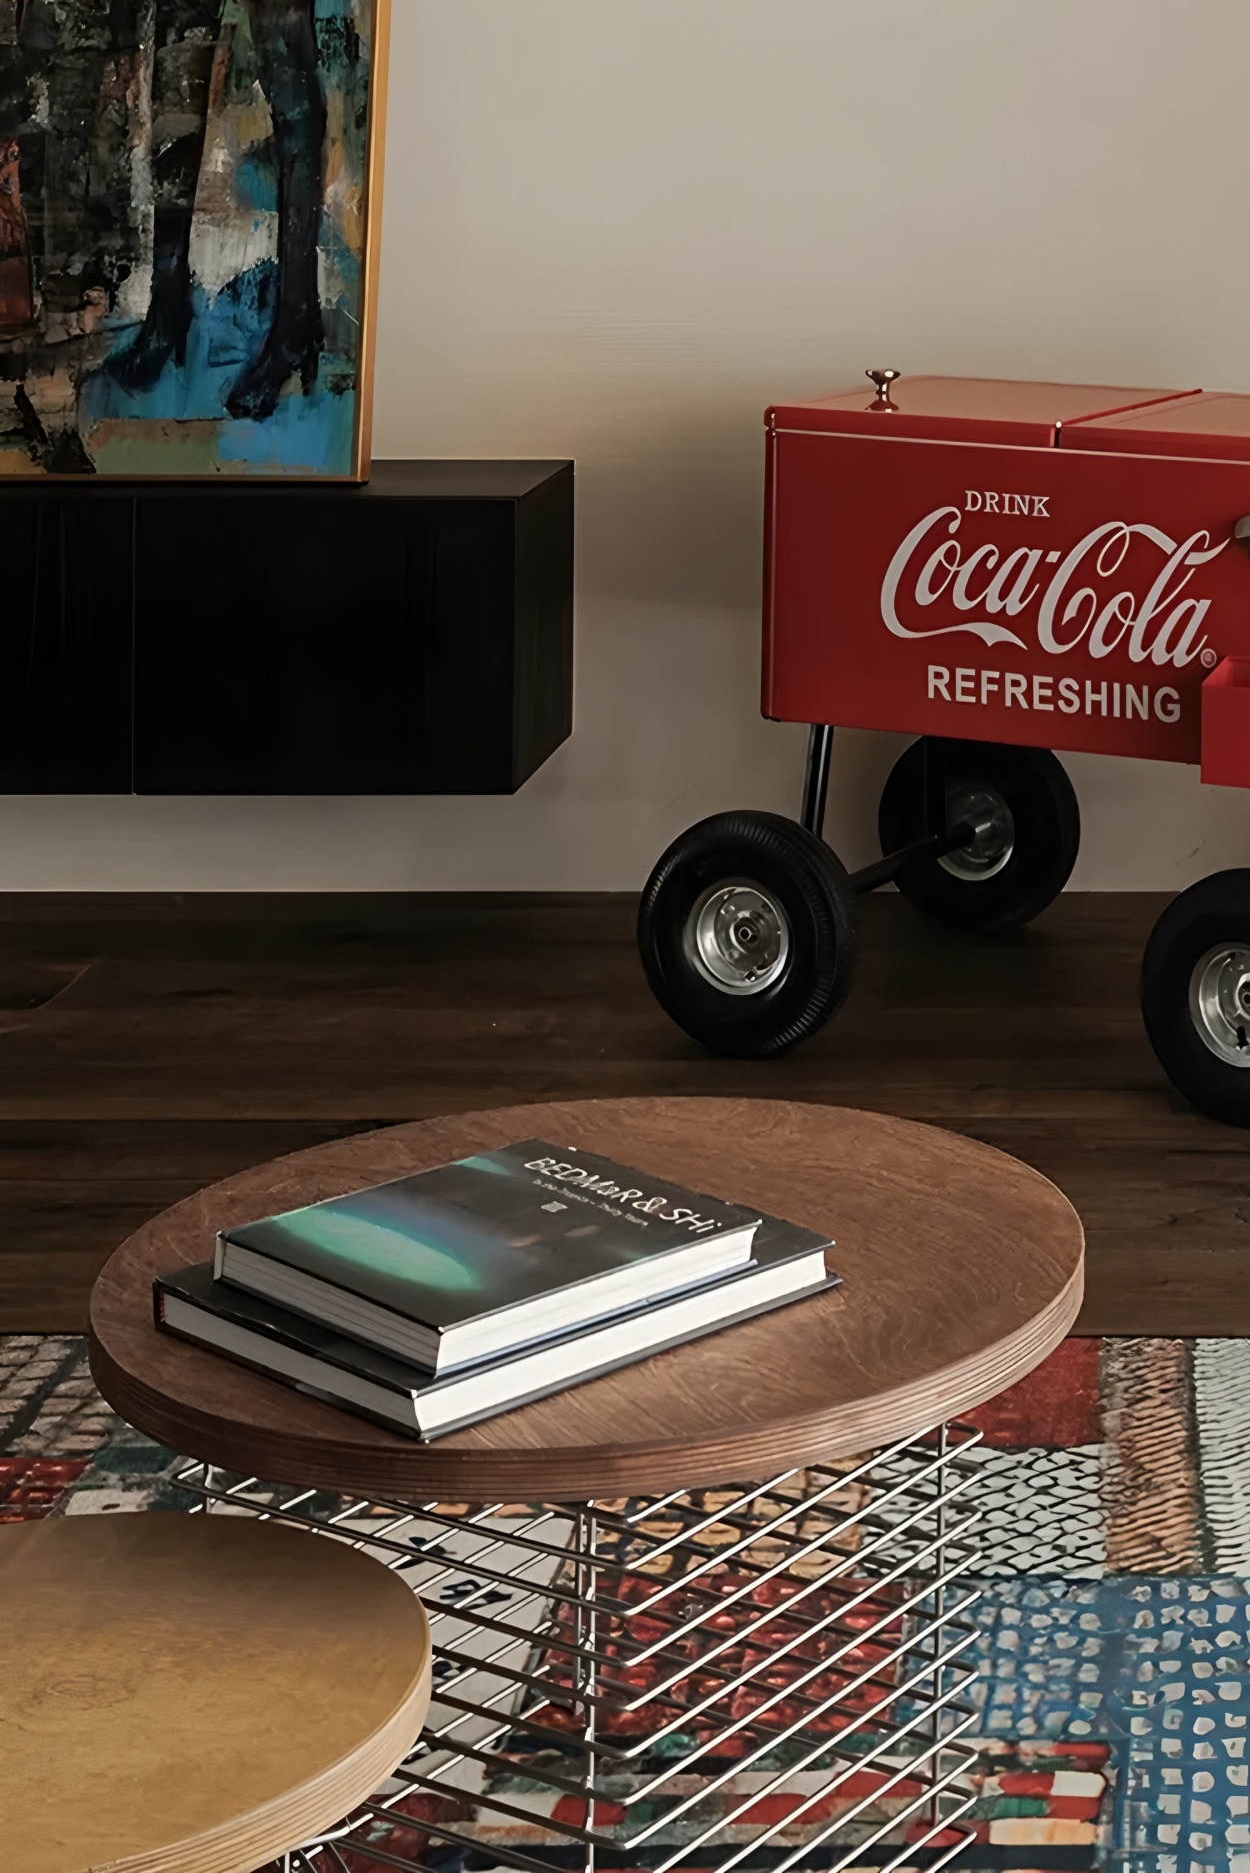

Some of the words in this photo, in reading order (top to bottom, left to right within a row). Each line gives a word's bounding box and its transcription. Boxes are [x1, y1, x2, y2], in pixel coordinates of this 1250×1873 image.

[964, 489, 1051, 517] DRINK
[880, 505, 1232, 668] Coca-Cola
[926, 664, 1181, 723] REFRESHING
[631, 1196, 668, 1214] &
